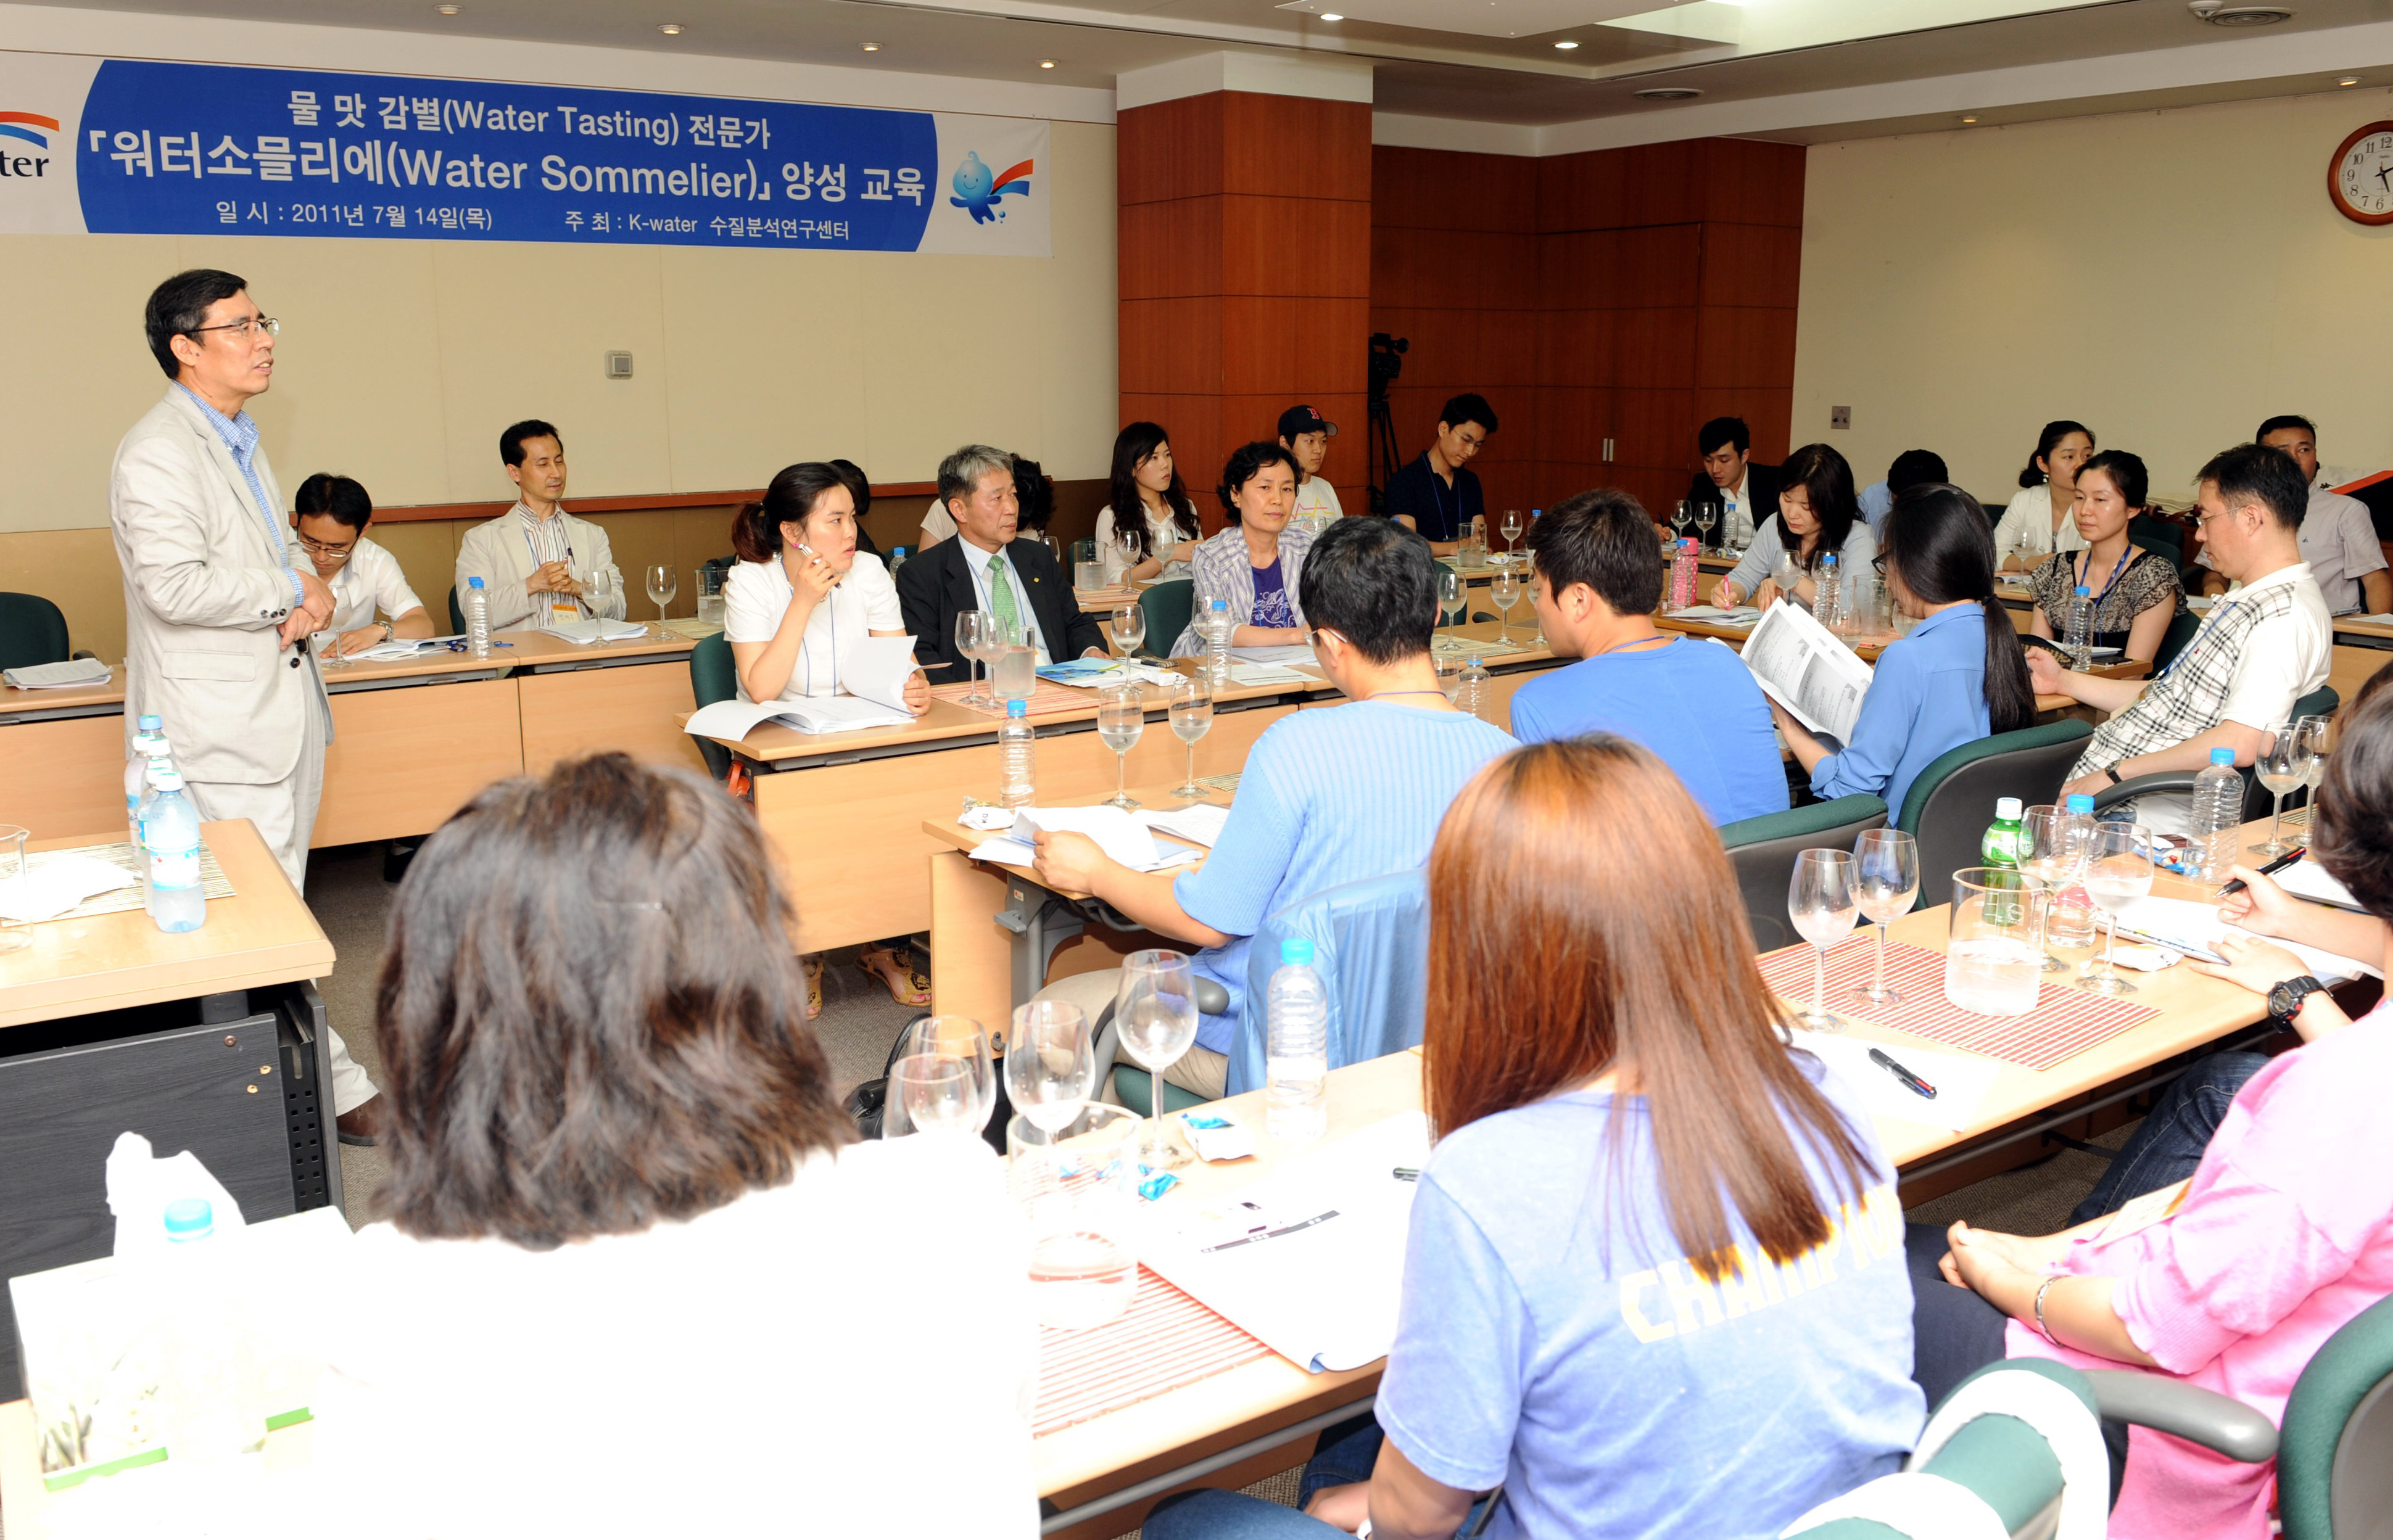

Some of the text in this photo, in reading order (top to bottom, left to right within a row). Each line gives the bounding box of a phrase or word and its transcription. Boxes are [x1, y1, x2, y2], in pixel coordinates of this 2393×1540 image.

[287, 91, 771, 150] 물 맛 감별(Water Tasting) 전문가
[2366, 142, 2374, 153] 11
[2381, 136, 2392, 149] 12
[2352, 153, 2363, 165] 10
[2347, 169, 2355, 181] 9
[782, 161, 846, 202] 양성
[861, 167, 925, 206] 교육
[2350, 184, 2358, 196] 8
[2362, 196, 2369, 207] 7
[2376, 197, 2384, 210] 6
[216, 200, 238, 223] 일
[247, 201, 268, 224] 시
[292, 204, 364, 226] 2011년
[373, 205, 406, 228] 7월
[415, 207, 492, 231] 14일(목)
[565, 211, 584, 232] 주
[592, 212, 610, 233] 최
[629, 213, 698, 233] K-water
[709, 216, 849, 240] 수질분석연구센터
